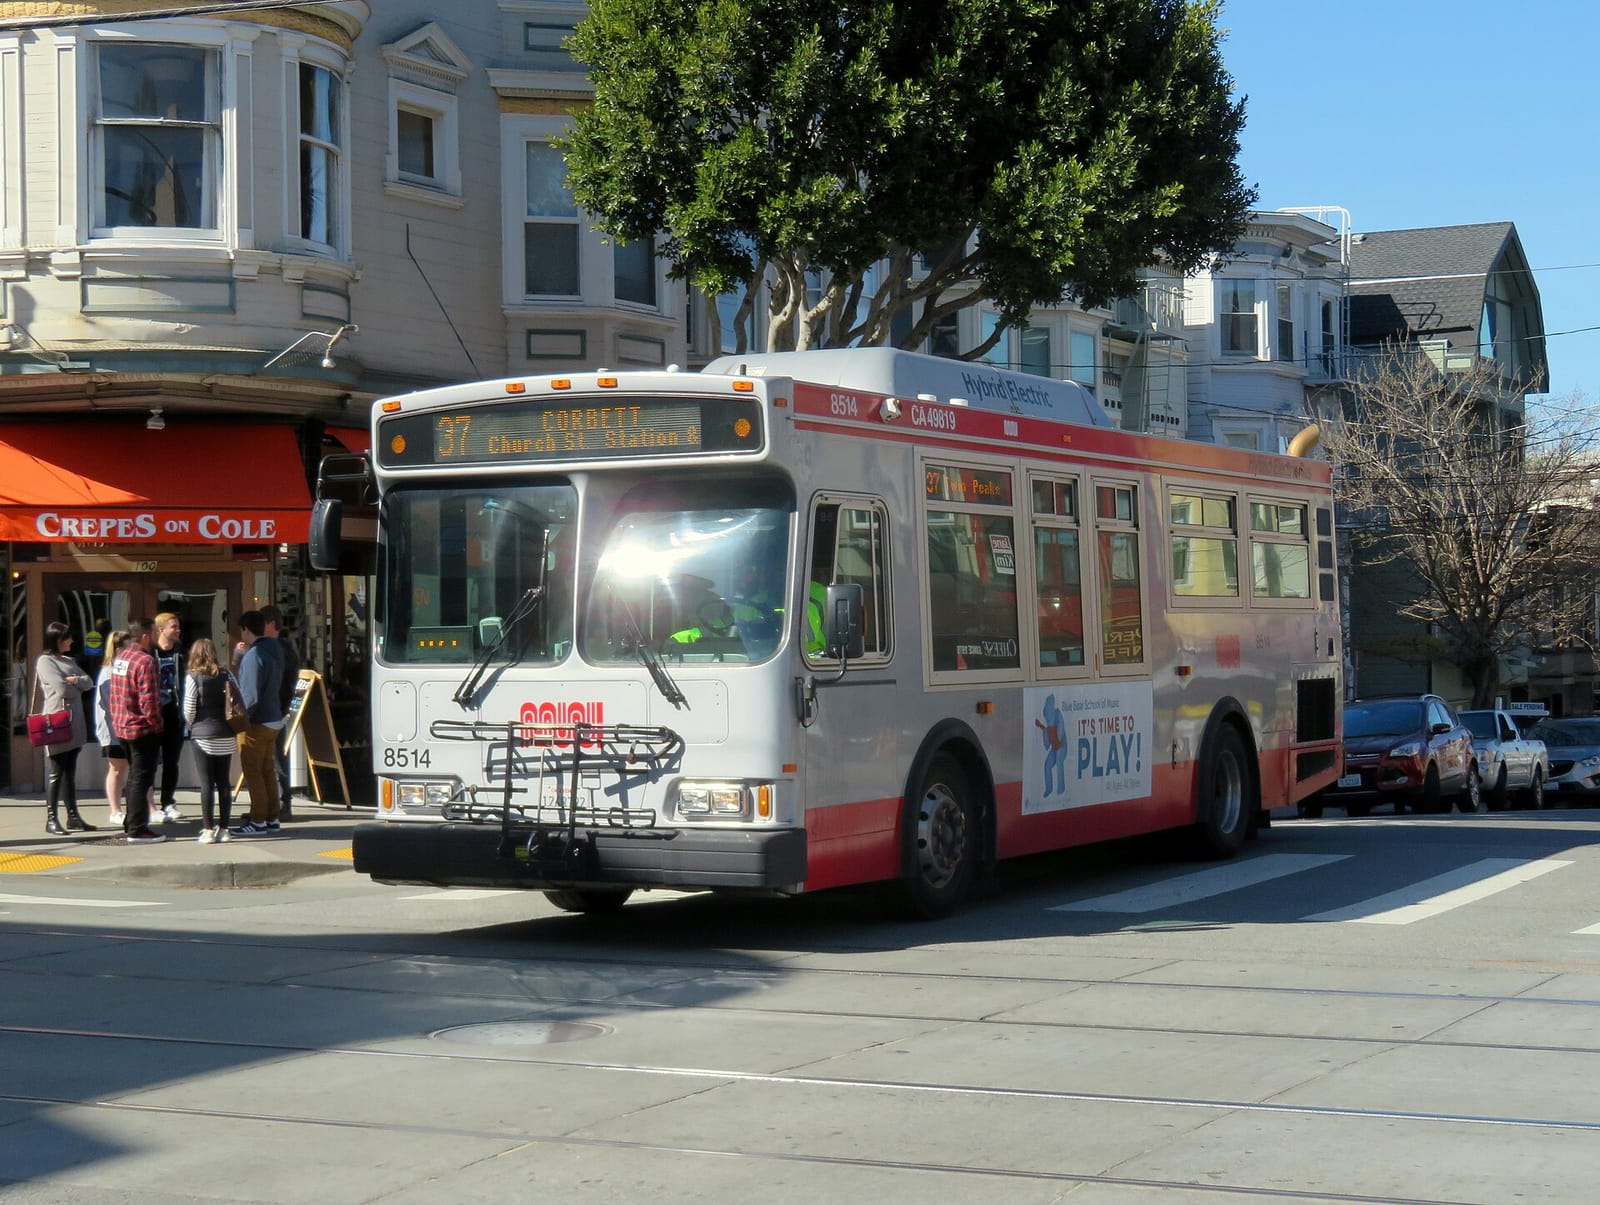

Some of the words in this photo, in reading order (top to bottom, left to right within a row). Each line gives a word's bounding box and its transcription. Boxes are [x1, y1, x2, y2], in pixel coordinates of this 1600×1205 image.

[961, 372, 1007, 400] Hybrid
[1006, 380, 1053, 408] Electric
[830, 393, 858, 417] 8514
[911, 404, 927, 426] CA
[927, 408, 956, 430] 49819
[542, 406, 641, 432] CORBETT
[438, 415, 472, 457] 37
[488, 434, 557, 454] Church
[605, 428, 679, 449] Station
[926, 471, 939, 494] 37
[972, 478, 1001, 496] Peaks
[36, 513, 156, 539] CREPES
[165, 520, 190, 533] ON
[198, 514, 276, 539] COLE
[135, 561, 156, 571] 100
[1078, 718, 1096, 736] IT'S
[1098, 716, 1120, 735] TIME
[1122, 715, 1135, 732] TO
[384, 748, 431, 769] 8514
[1077, 732, 1142, 779] PLAY!
